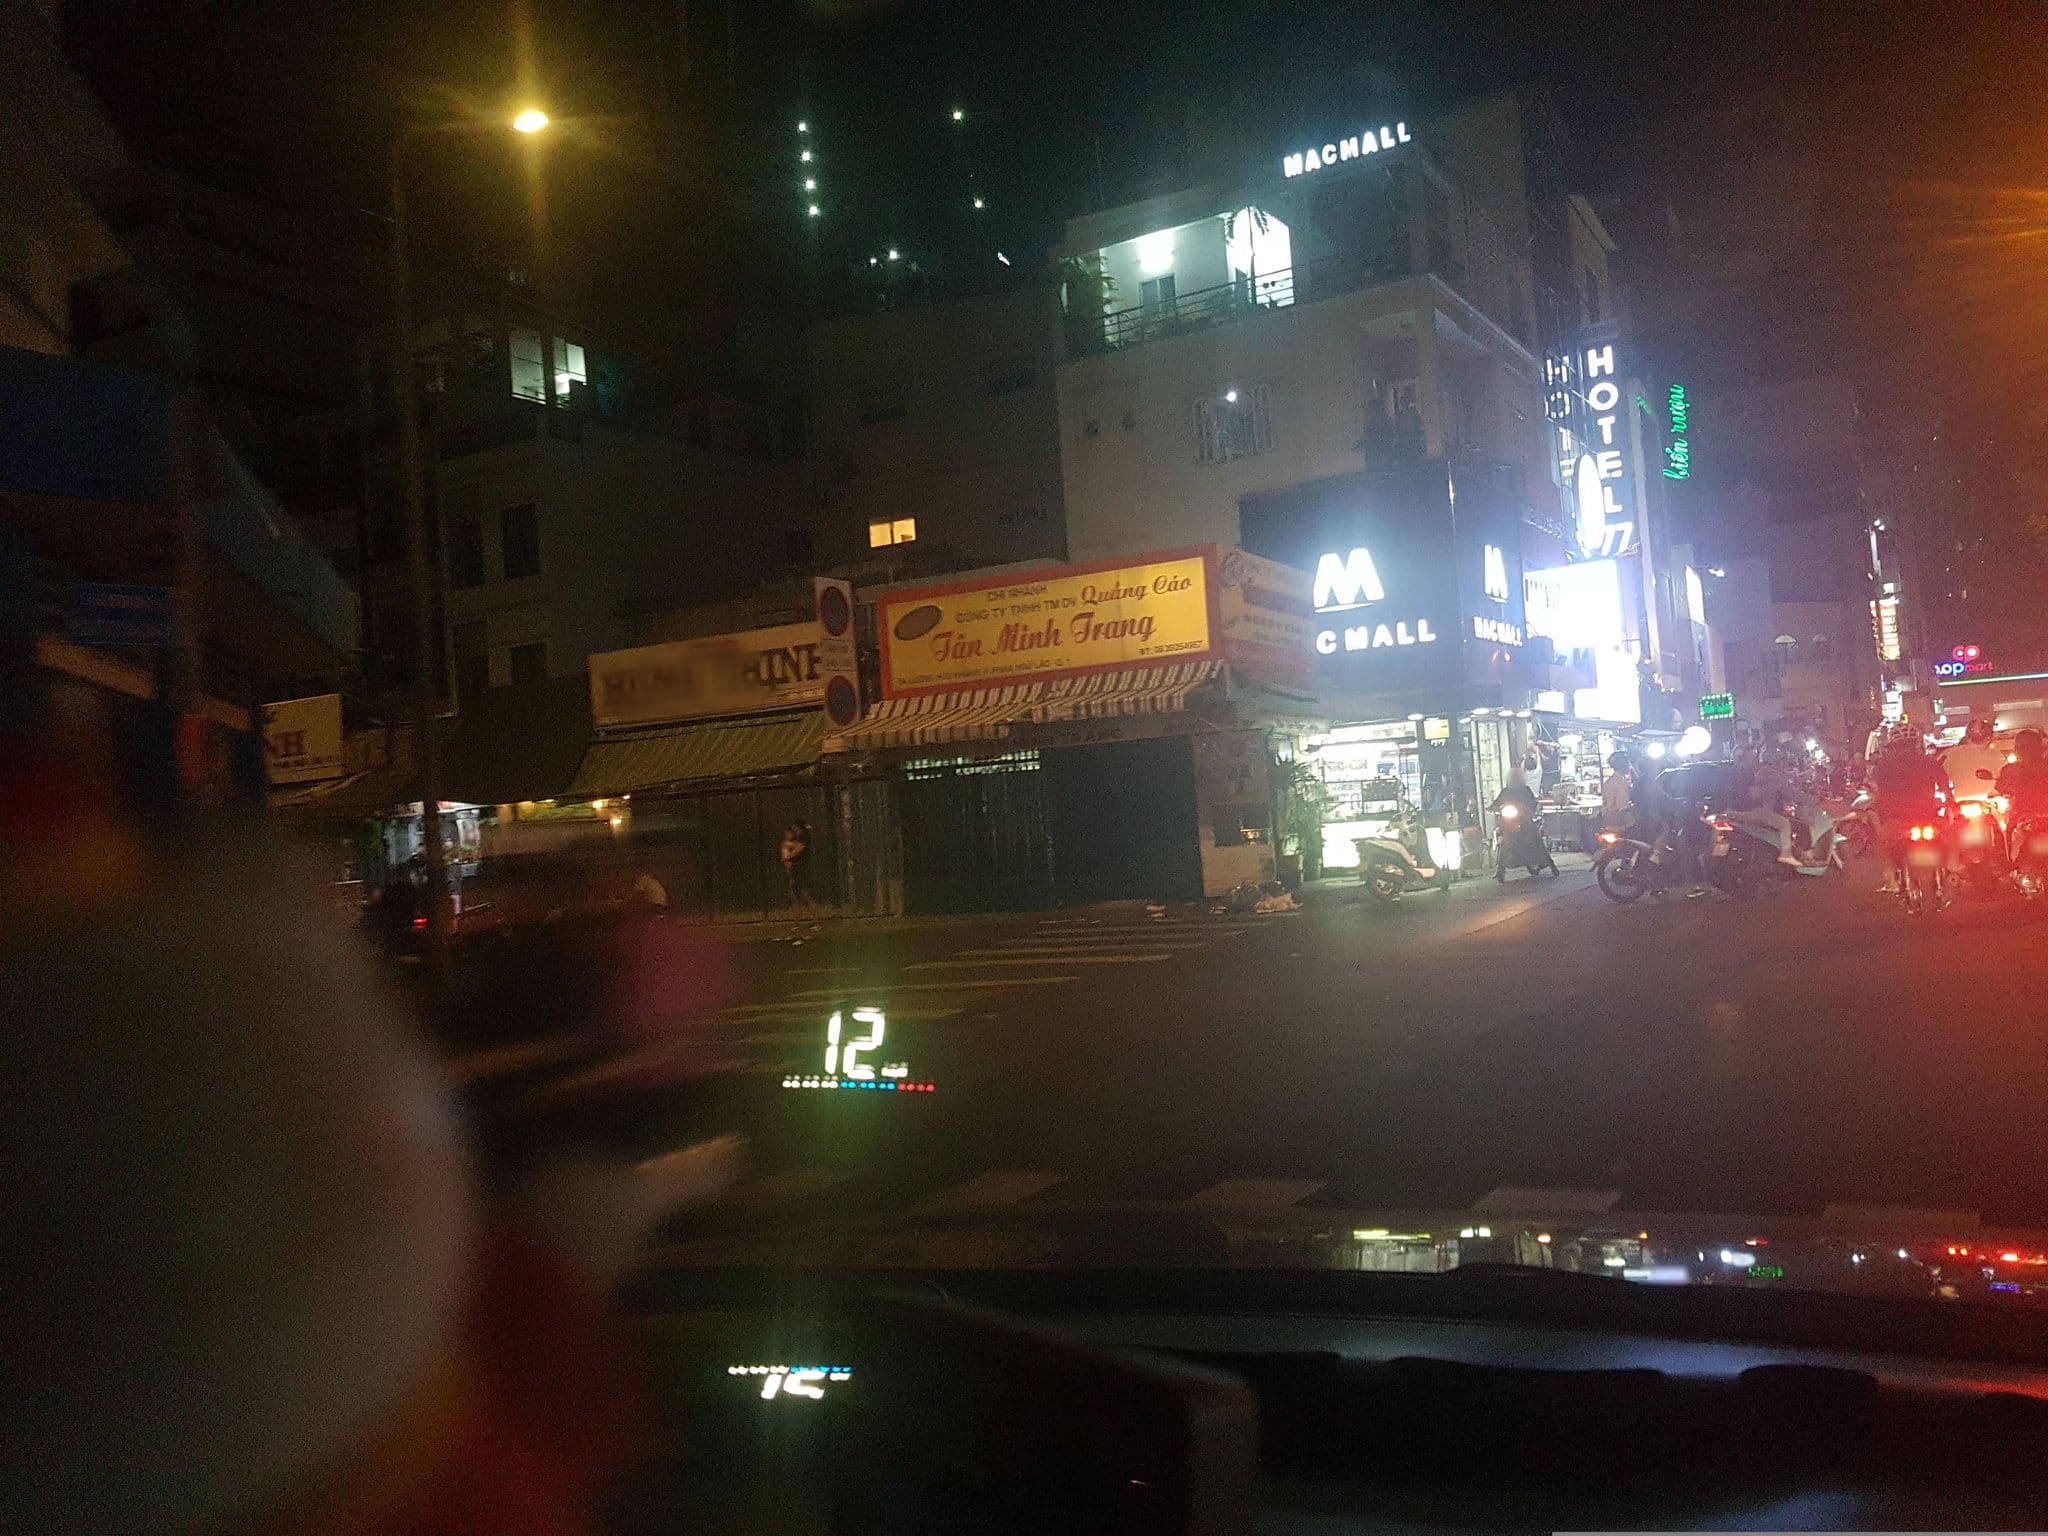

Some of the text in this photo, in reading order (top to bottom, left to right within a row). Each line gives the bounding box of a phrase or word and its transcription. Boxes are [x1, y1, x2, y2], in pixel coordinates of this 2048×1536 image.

[1283, 122, 1412, 178] MACMALL
[1081, 581, 1149, 605] Quảng
[1152, 574, 1193, 595] Cáo
[988, 617, 1063, 655] Minh
[1070, 611, 1157, 643] Trang
[1473, 615, 1524, 648] MACMALL
[825, 1006, 885, 1080] 12
